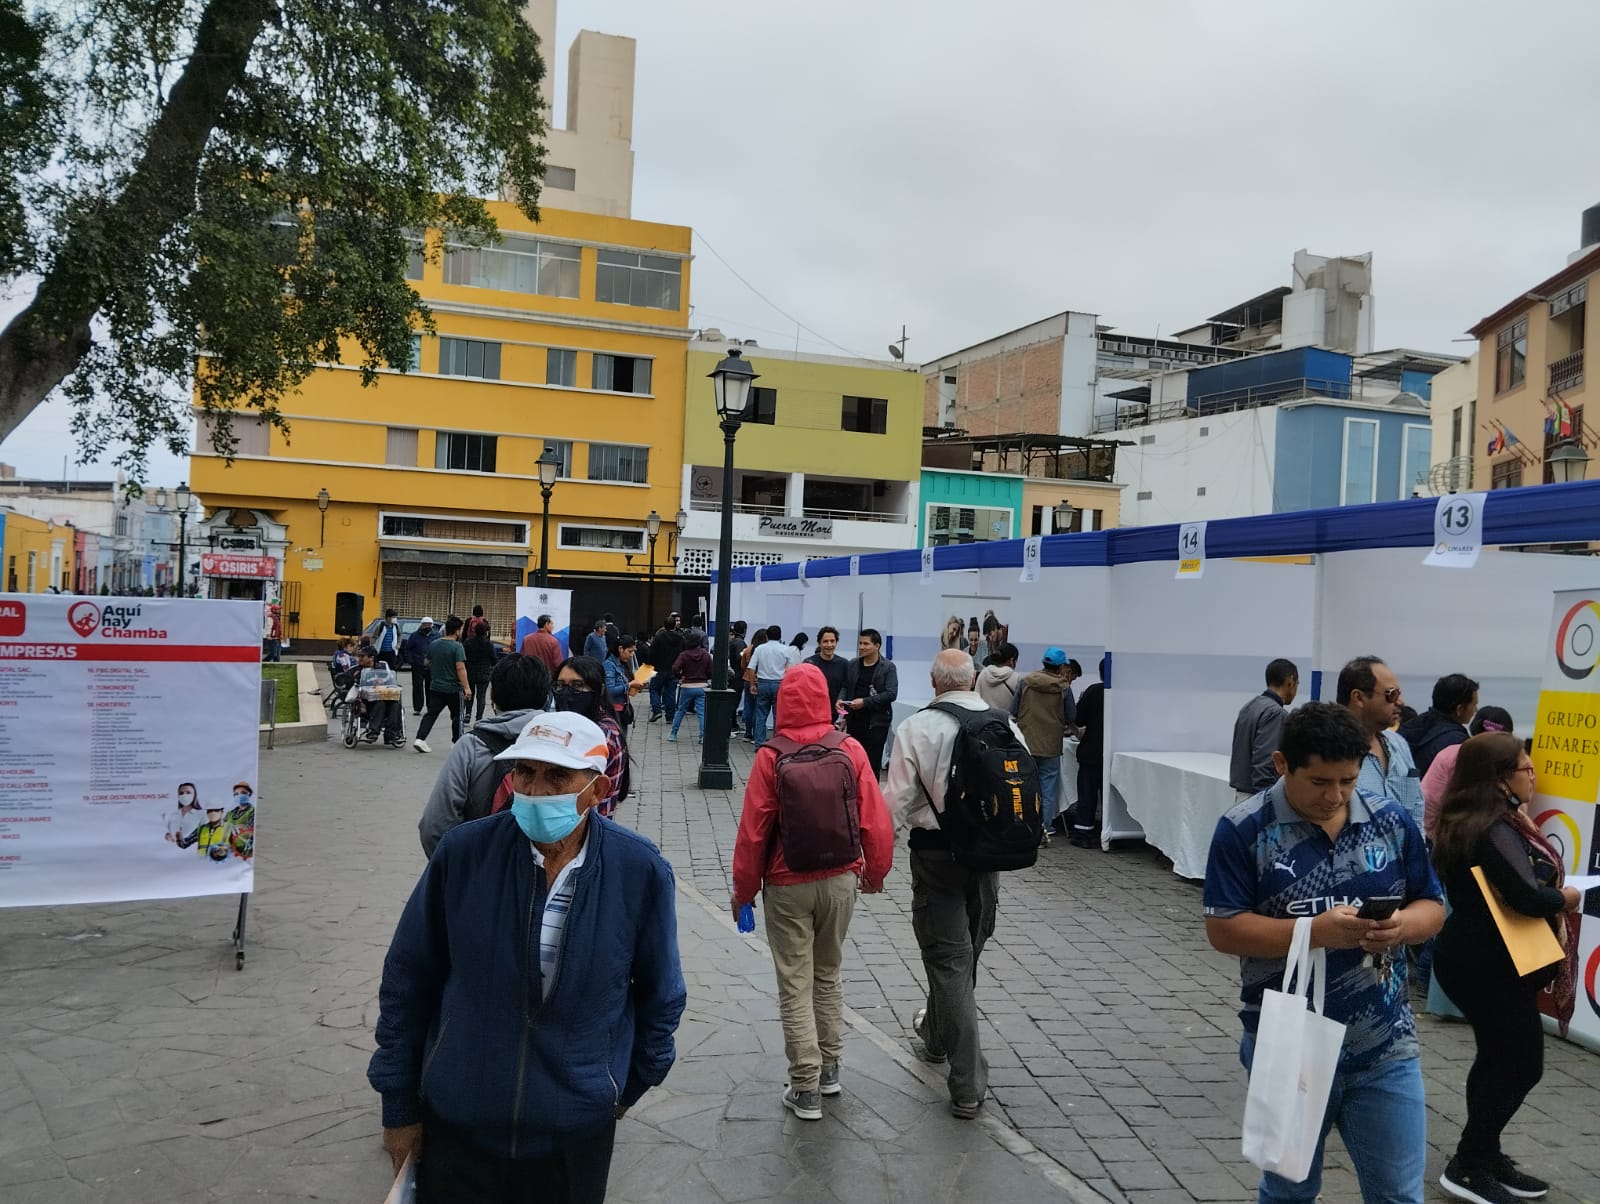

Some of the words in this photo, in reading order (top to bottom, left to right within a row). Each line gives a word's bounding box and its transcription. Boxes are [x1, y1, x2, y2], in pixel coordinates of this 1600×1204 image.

[760, 516, 797, 531] Puerto
[801, 519, 832, 533] Mori
[1442, 505, 1469, 528] 13
[1183, 531, 1198, 549] 14
[1026, 544, 1036, 558] 15
[220, 561, 257, 573] OSIRIS
[102, 604, 142, 619] Aquí
[101, 615, 132, 629] hay
[101, 626, 168, 639] Chamba
[0, 645, 78, 658] MPRESAS
[1547, 711, 1597, 729] GRUPO
[1537, 734, 1600, 756] LINARES
[1544, 760, 1584, 779] PERÚ
[1286, 895, 1364, 915] ETIHA
